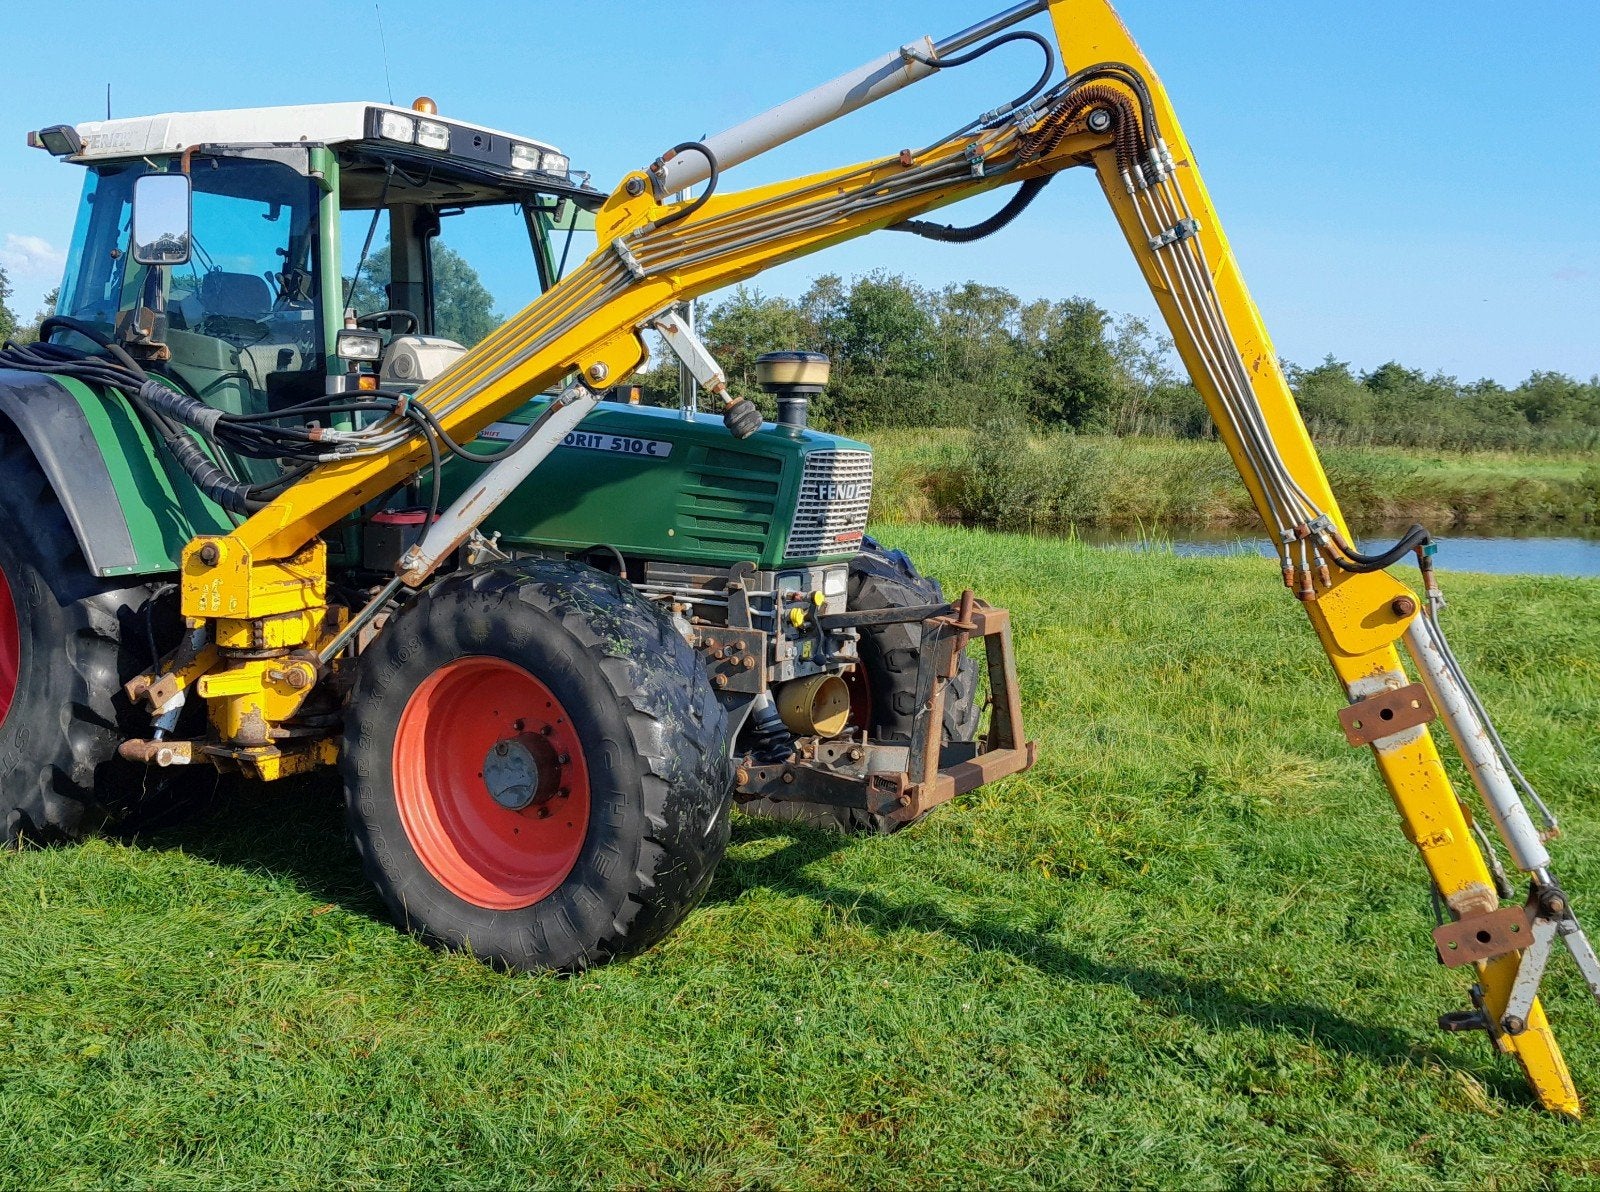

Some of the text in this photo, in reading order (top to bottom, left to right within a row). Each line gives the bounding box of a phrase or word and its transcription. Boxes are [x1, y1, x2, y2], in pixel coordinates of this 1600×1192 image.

[564, 432, 657, 455] ORIT 510 C
